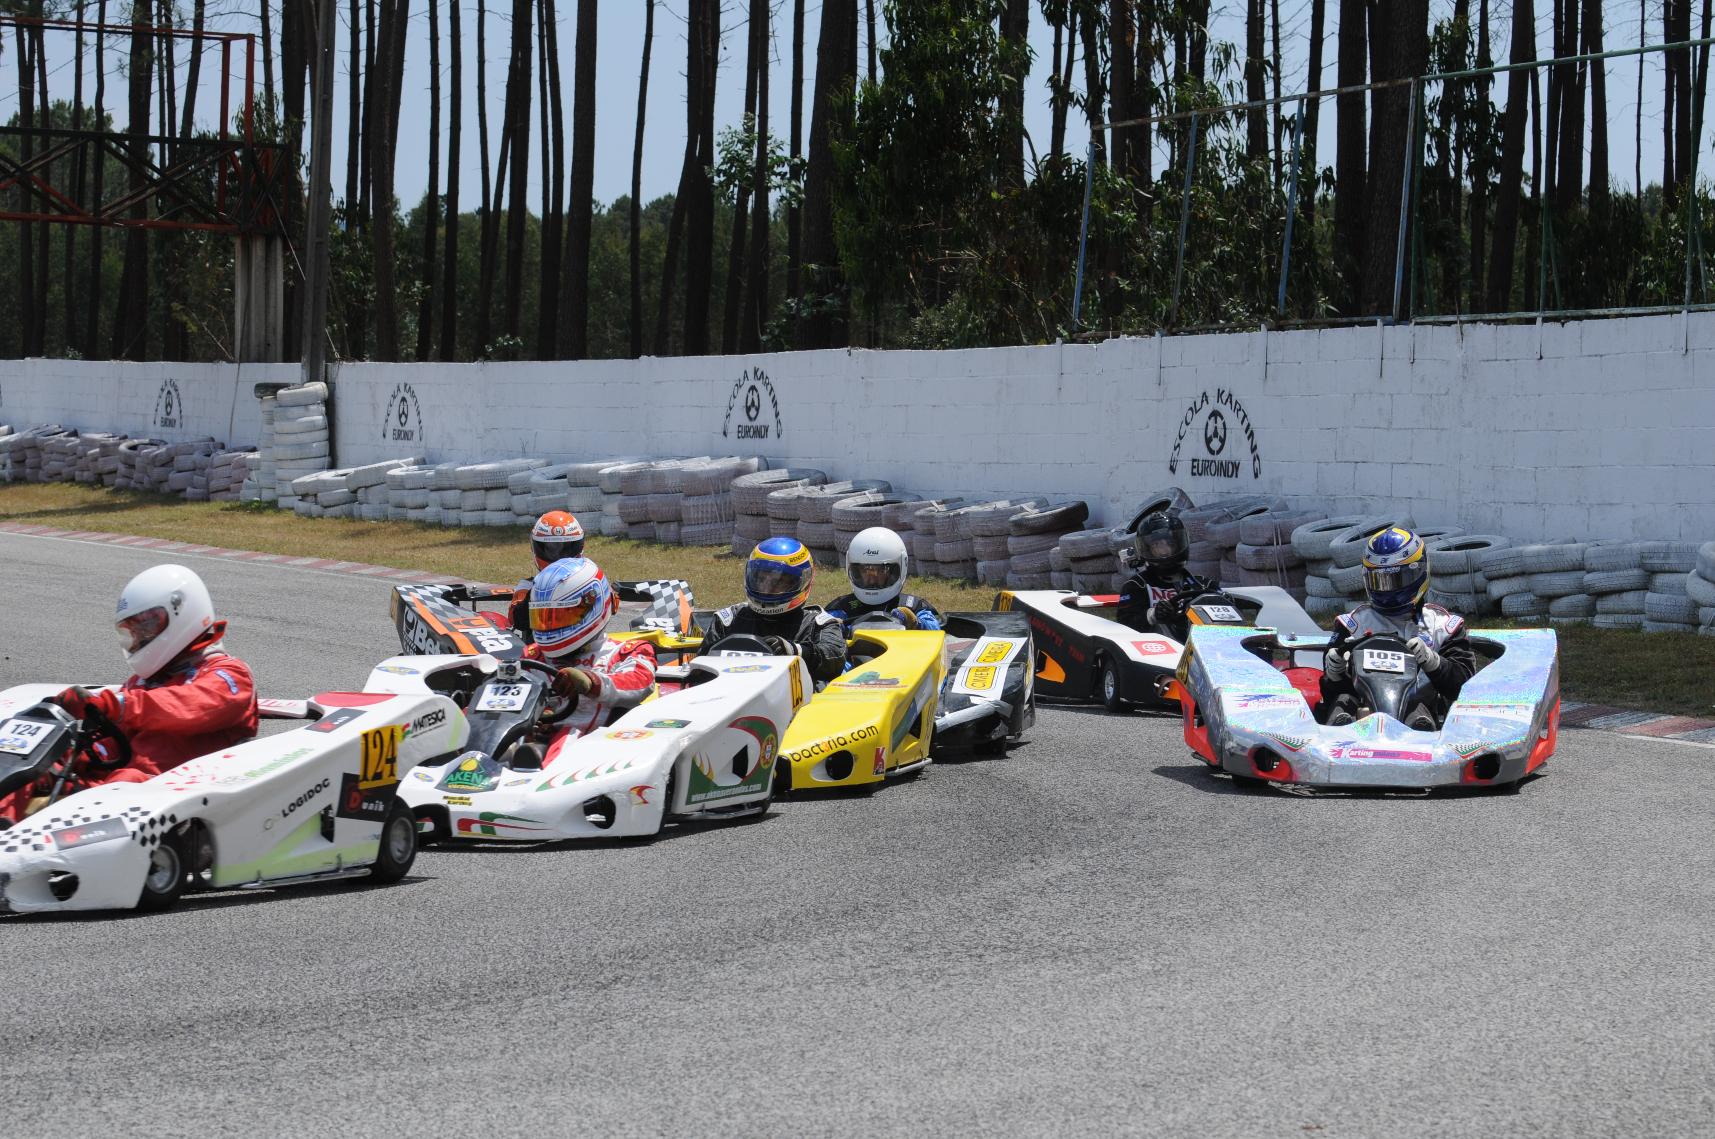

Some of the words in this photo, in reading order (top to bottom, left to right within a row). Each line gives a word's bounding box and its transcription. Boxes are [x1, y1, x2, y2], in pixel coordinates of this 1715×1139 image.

[1169, 391, 1209, 475] ESCOLA
[1216, 388, 1261, 480] KARTING
[1190, 458, 1241, 479] EUROINDY
[1366, 650, 1403, 661] 105
[491, 685, 522, 696] 123
[10, 723, 42, 737] 124
[360, 727, 397, 782] 124
[281, 777, 331, 818] LOGIDOC
